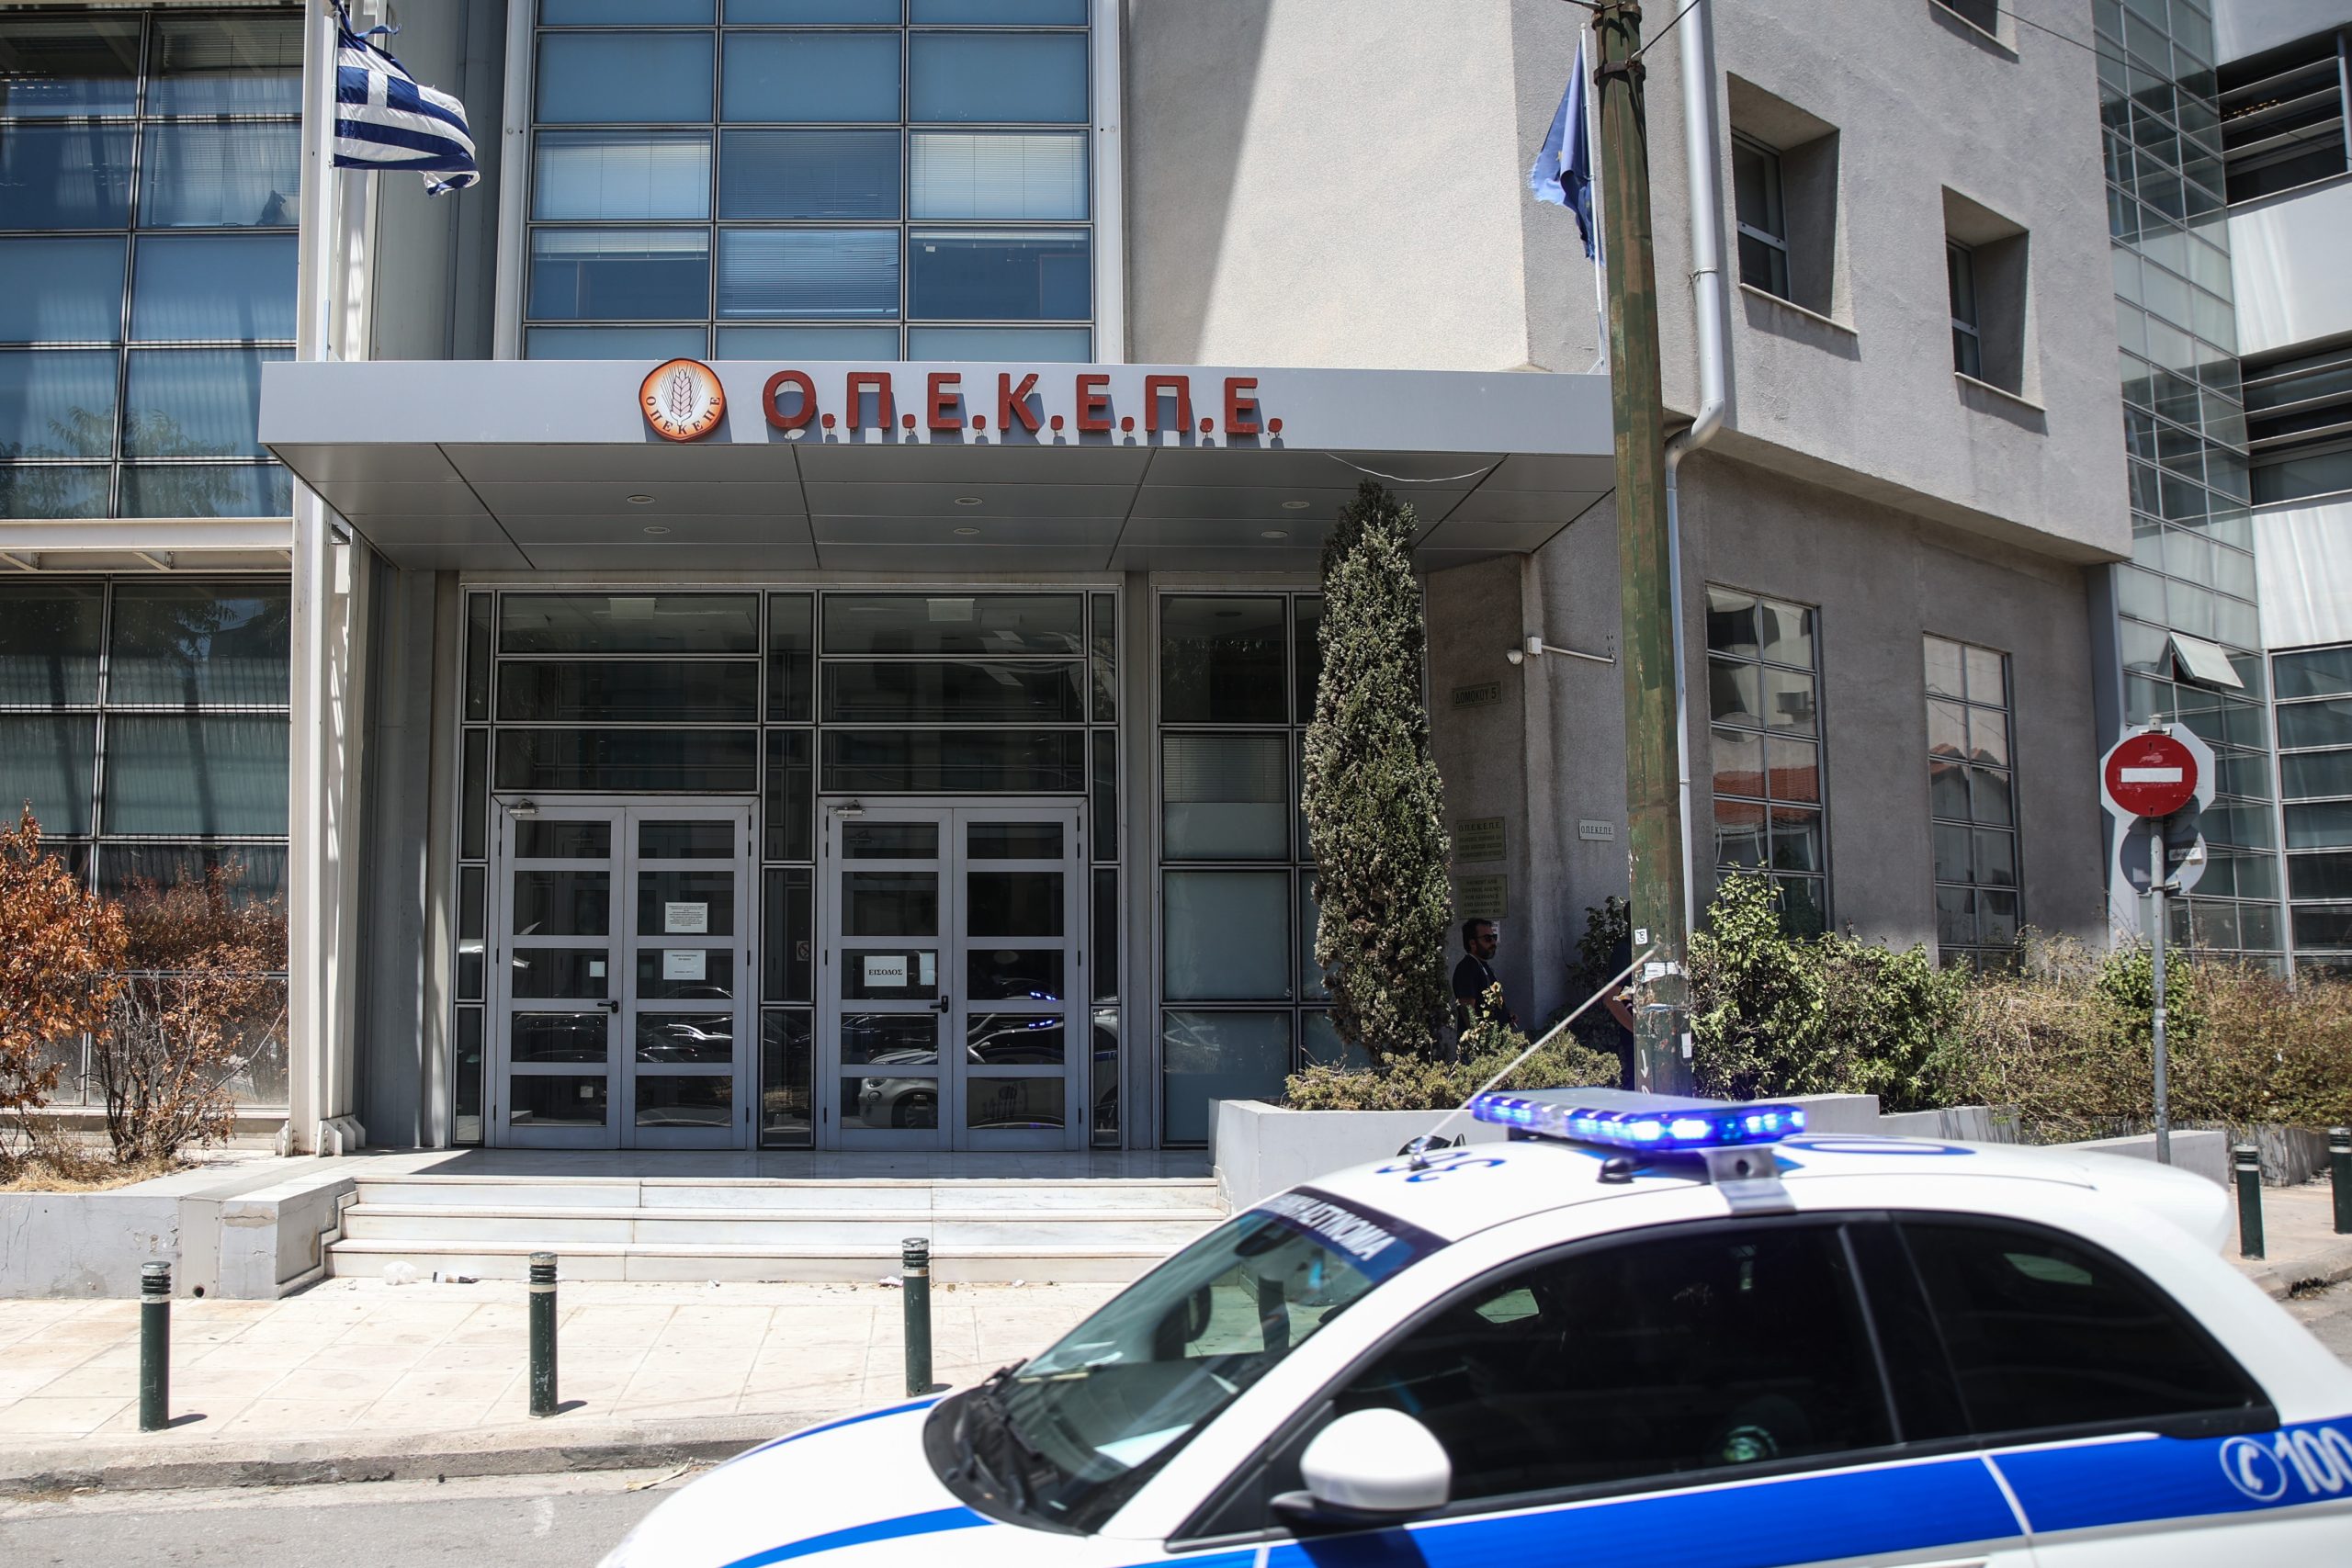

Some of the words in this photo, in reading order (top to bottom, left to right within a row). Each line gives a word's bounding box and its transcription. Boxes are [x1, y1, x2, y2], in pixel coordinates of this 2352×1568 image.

[646, 396, 720, 434] ΟΠΕΚΕΠΕ
[762, 369, 1283, 436] Ο.Π.Ε.Κ.Ε.Π.Ε.
[1455, 688, 1488, 704] ΔΟΜΟΚΟΥ
[1491, 687, 1497, 699] 5
